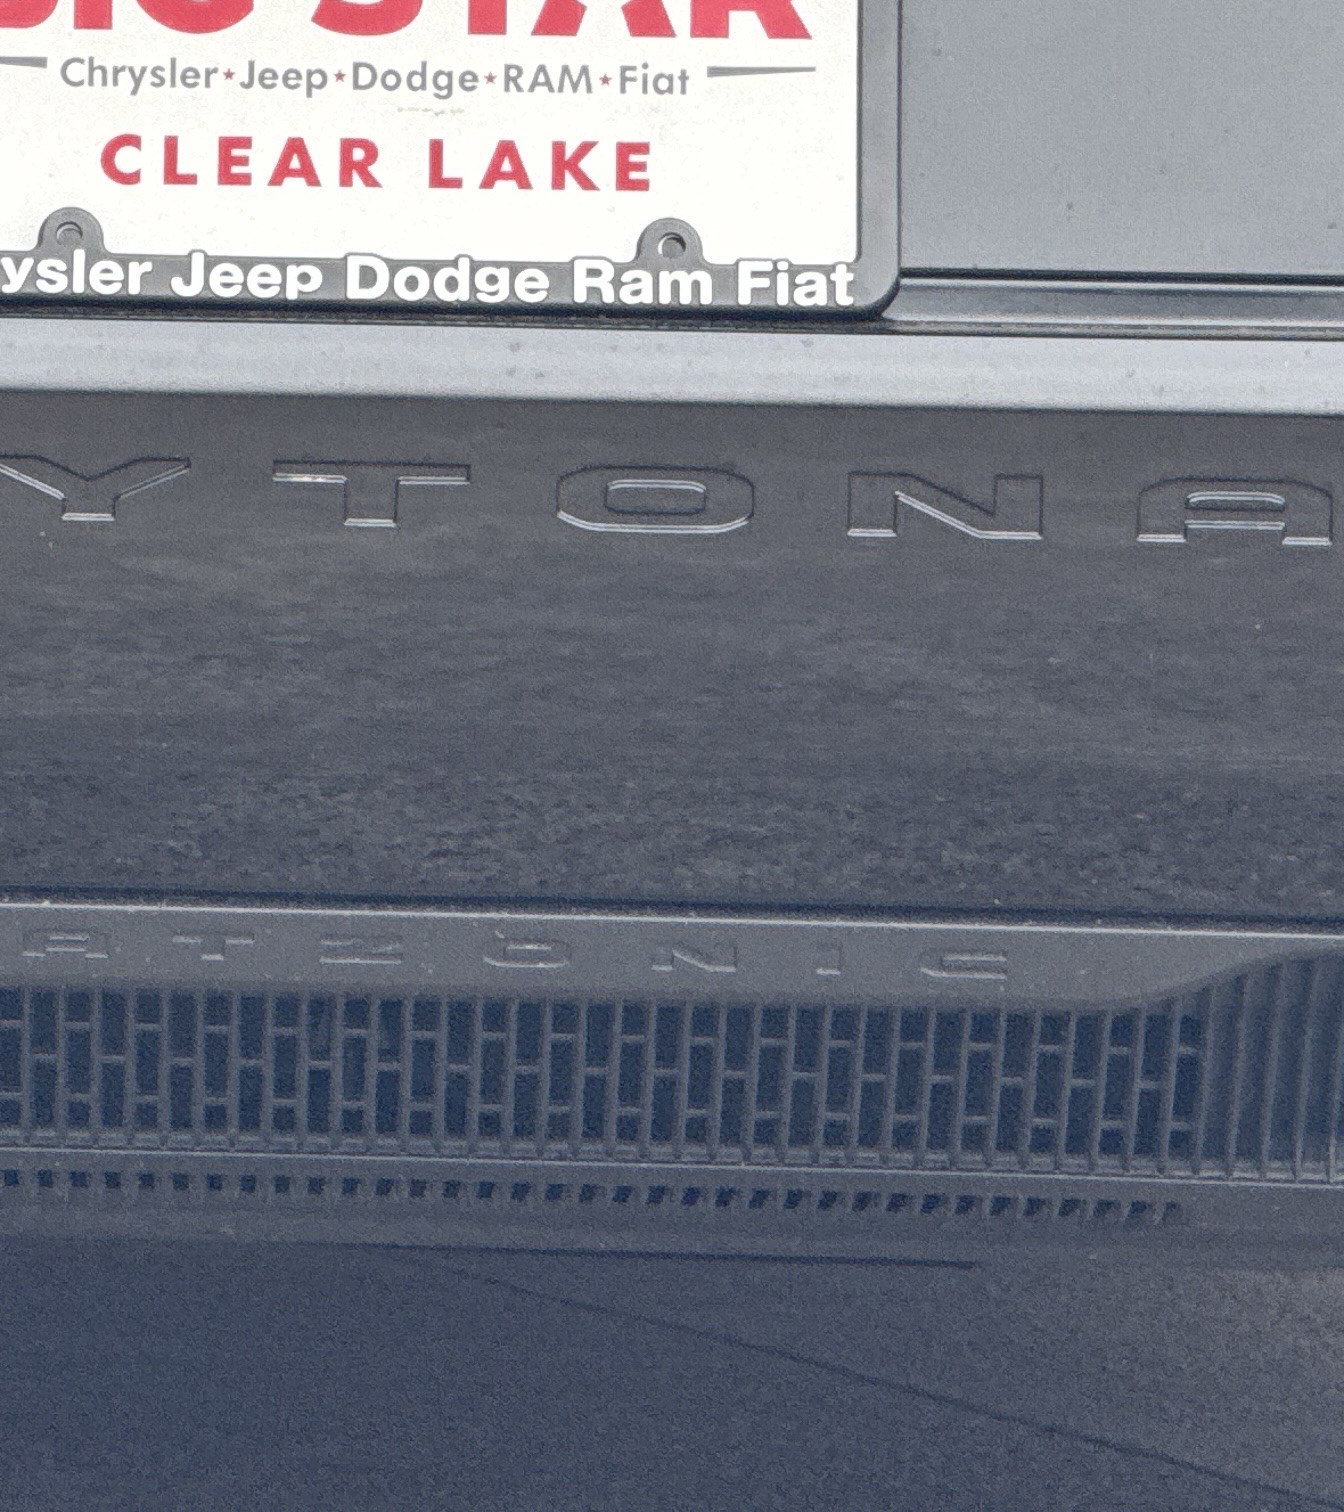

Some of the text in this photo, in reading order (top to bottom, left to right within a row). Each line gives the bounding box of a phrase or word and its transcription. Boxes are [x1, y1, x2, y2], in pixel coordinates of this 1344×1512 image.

[101, 134, 649, 191] CLEAR LAKE
[170, 251, 323, 299] Jeep
[346, 254, 550, 303] Dodge
[573, 258, 712, 305] Ram
[737, 259, 854, 306] Fiat
